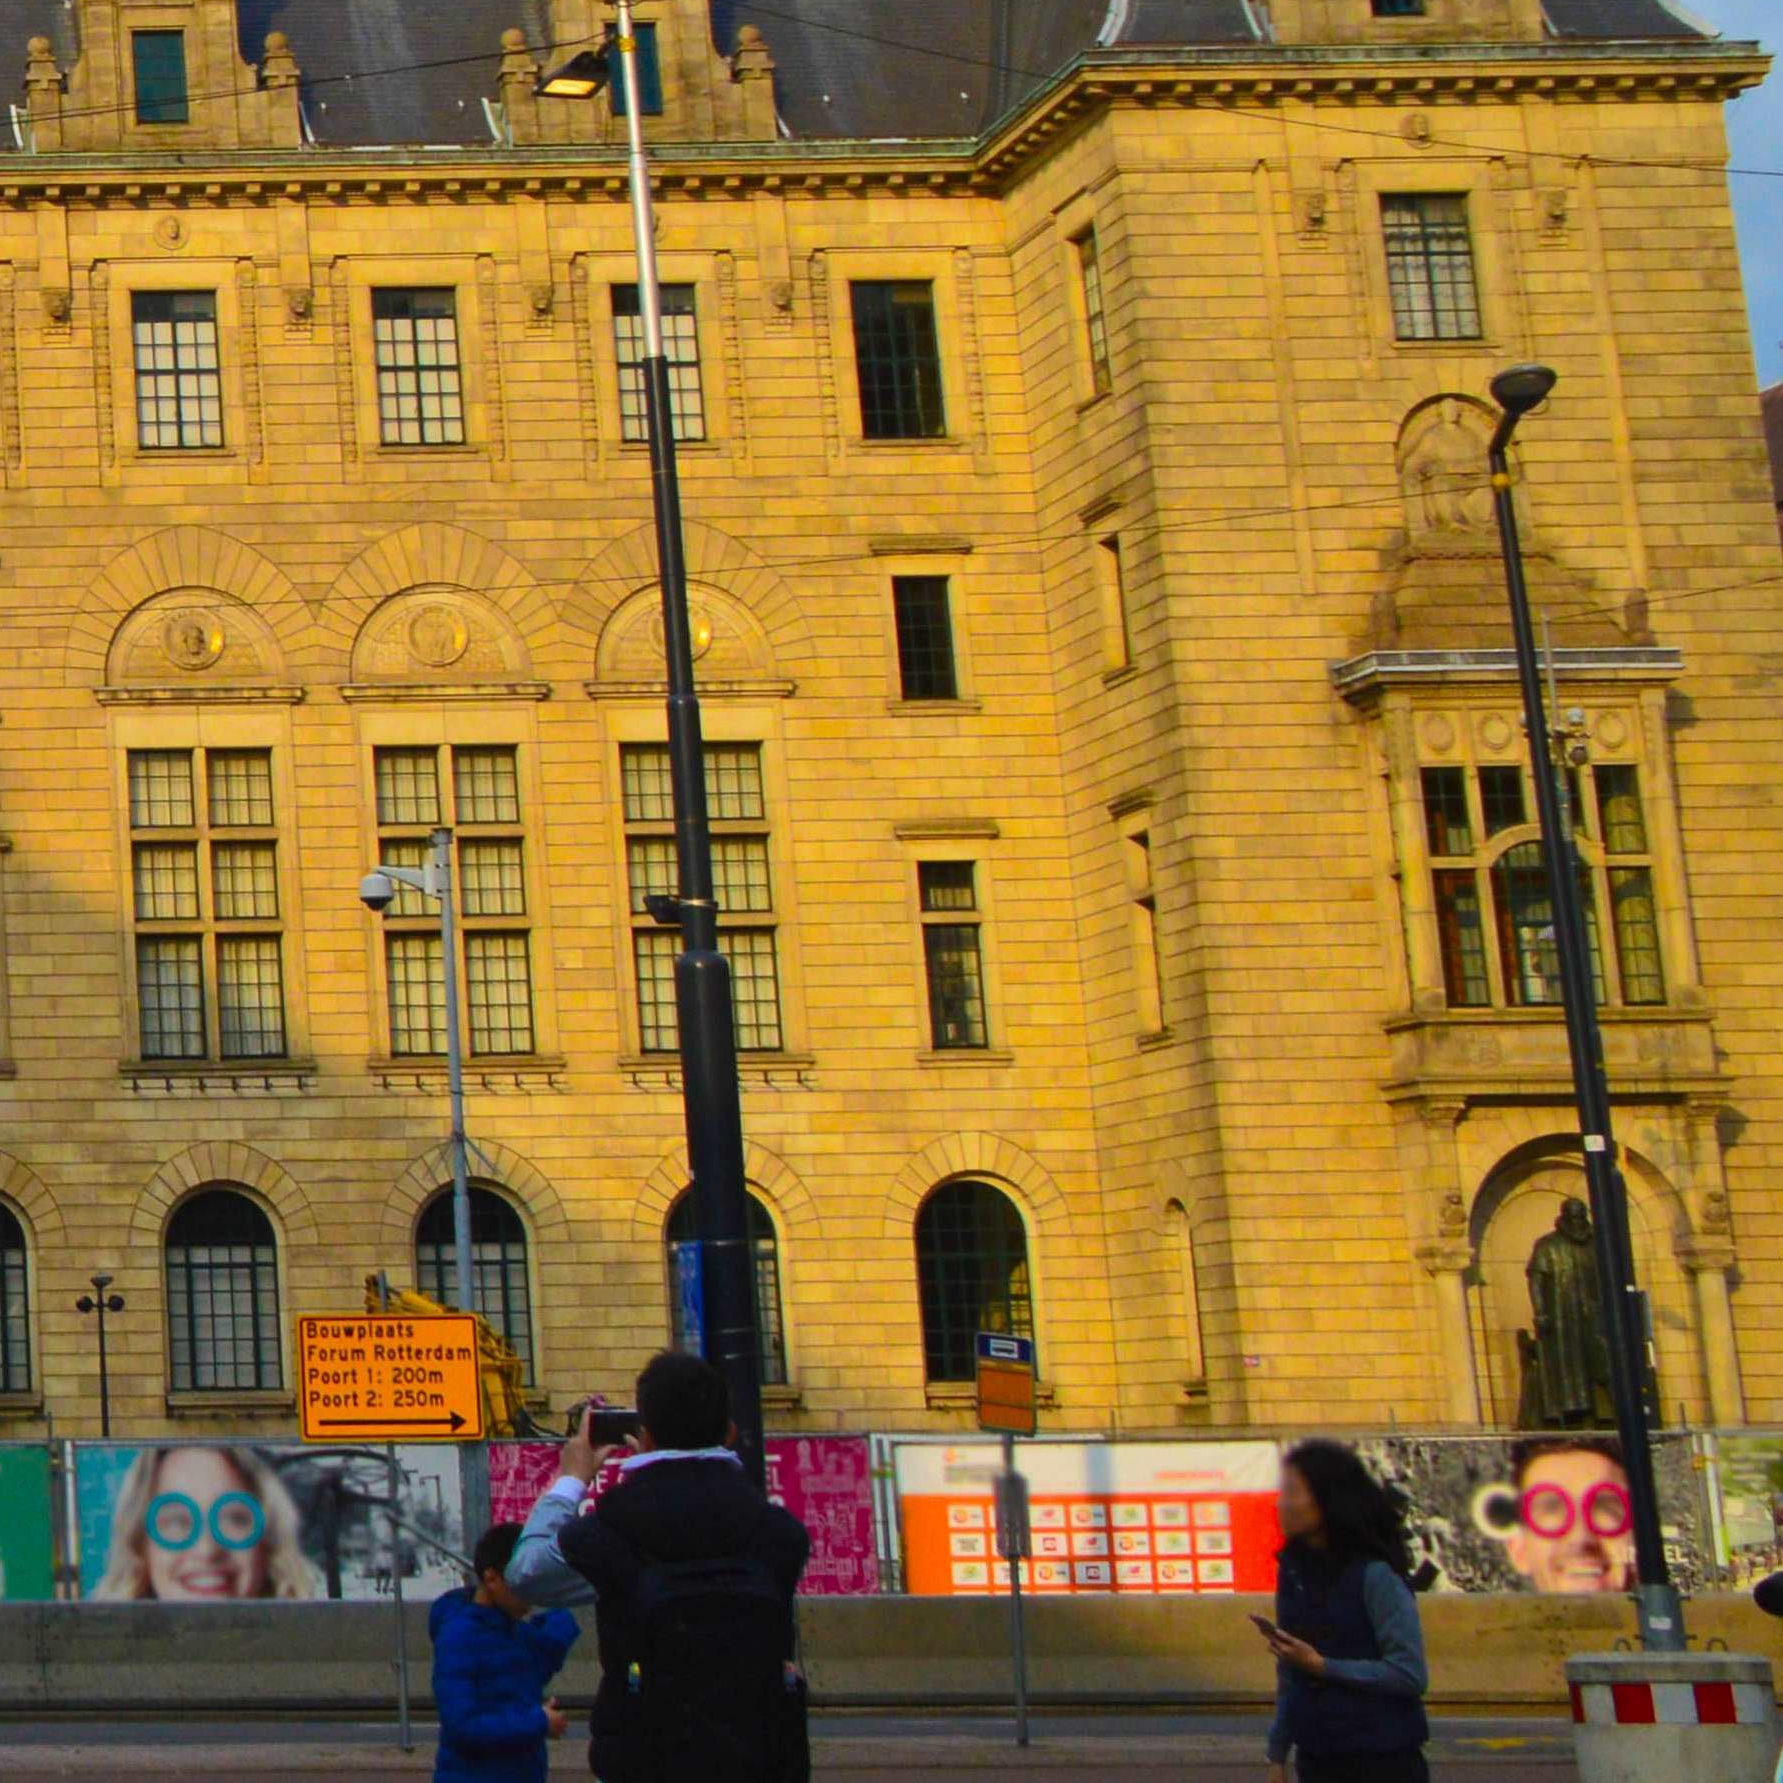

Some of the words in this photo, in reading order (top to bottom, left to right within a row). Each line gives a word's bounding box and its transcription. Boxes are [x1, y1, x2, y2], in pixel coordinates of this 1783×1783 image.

[306, 1322, 414, 1341] Bouwplaats
[307, 1345, 366, 1362] Forum
[374, 1344, 472, 1362] Rotterdam
[308, 1368, 358, 1385] Poort
[367, 1368, 382, 1385] 1:
[392, 1367, 444, 1385] 200m
[309, 1391, 359, 1408] Poort
[366, 1390, 384, 1408] 2:
[393, 1390, 445, 1408] 250m
